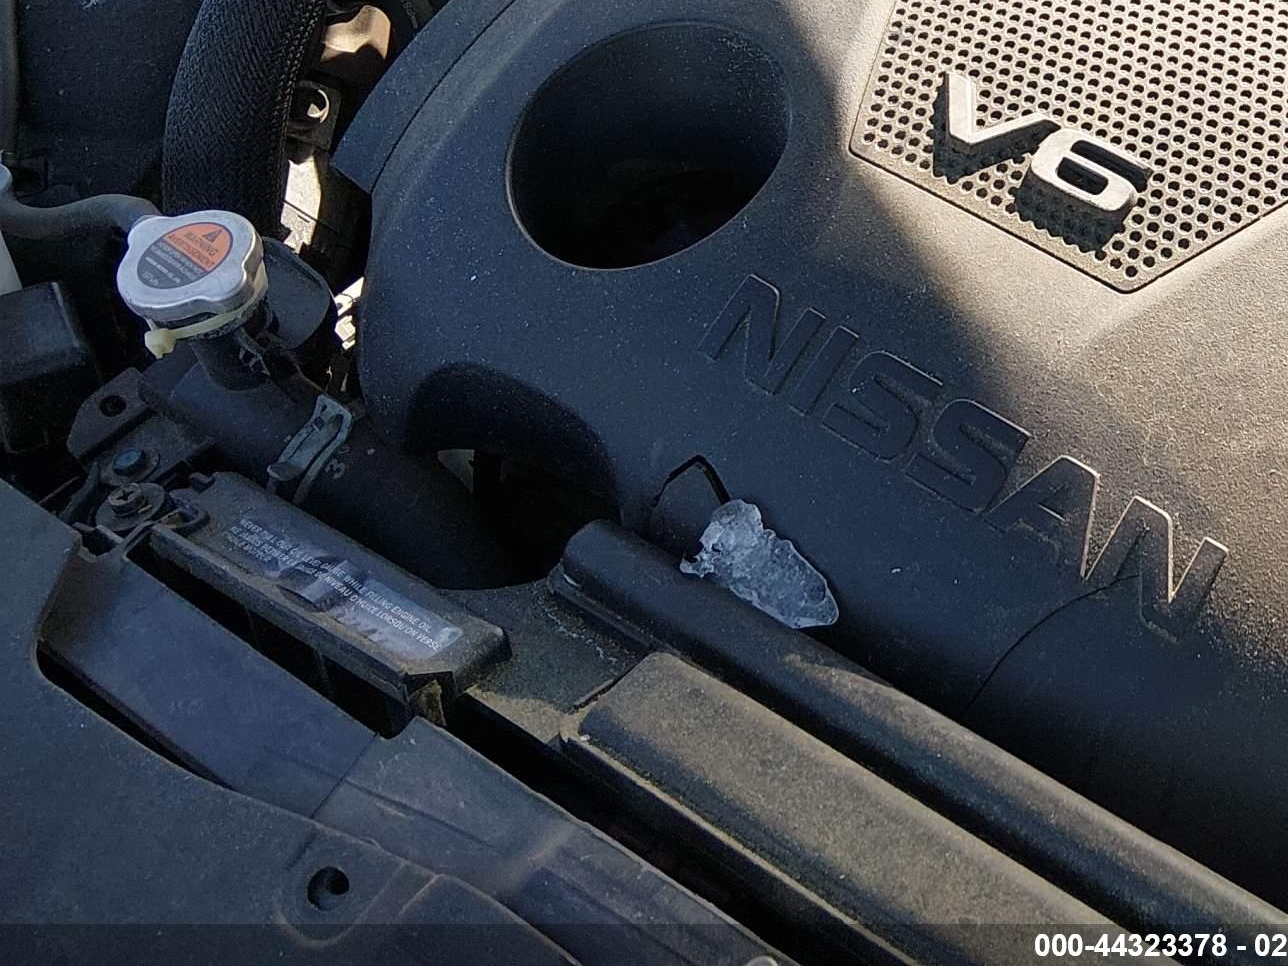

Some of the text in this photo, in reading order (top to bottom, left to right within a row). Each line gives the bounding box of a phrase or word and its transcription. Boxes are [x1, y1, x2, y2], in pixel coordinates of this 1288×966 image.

[942, 71, 1154, 212] V6
[699, 273, 1230, 643] NISSAN
[323, 577, 352, 595] NIVEAU
[416, 634, 442, 650] VERSE
[342, 576, 369, 593] WHILE
[364, 591, 392, 608] FILLING
[391, 605, 420, 624] ENGINE
